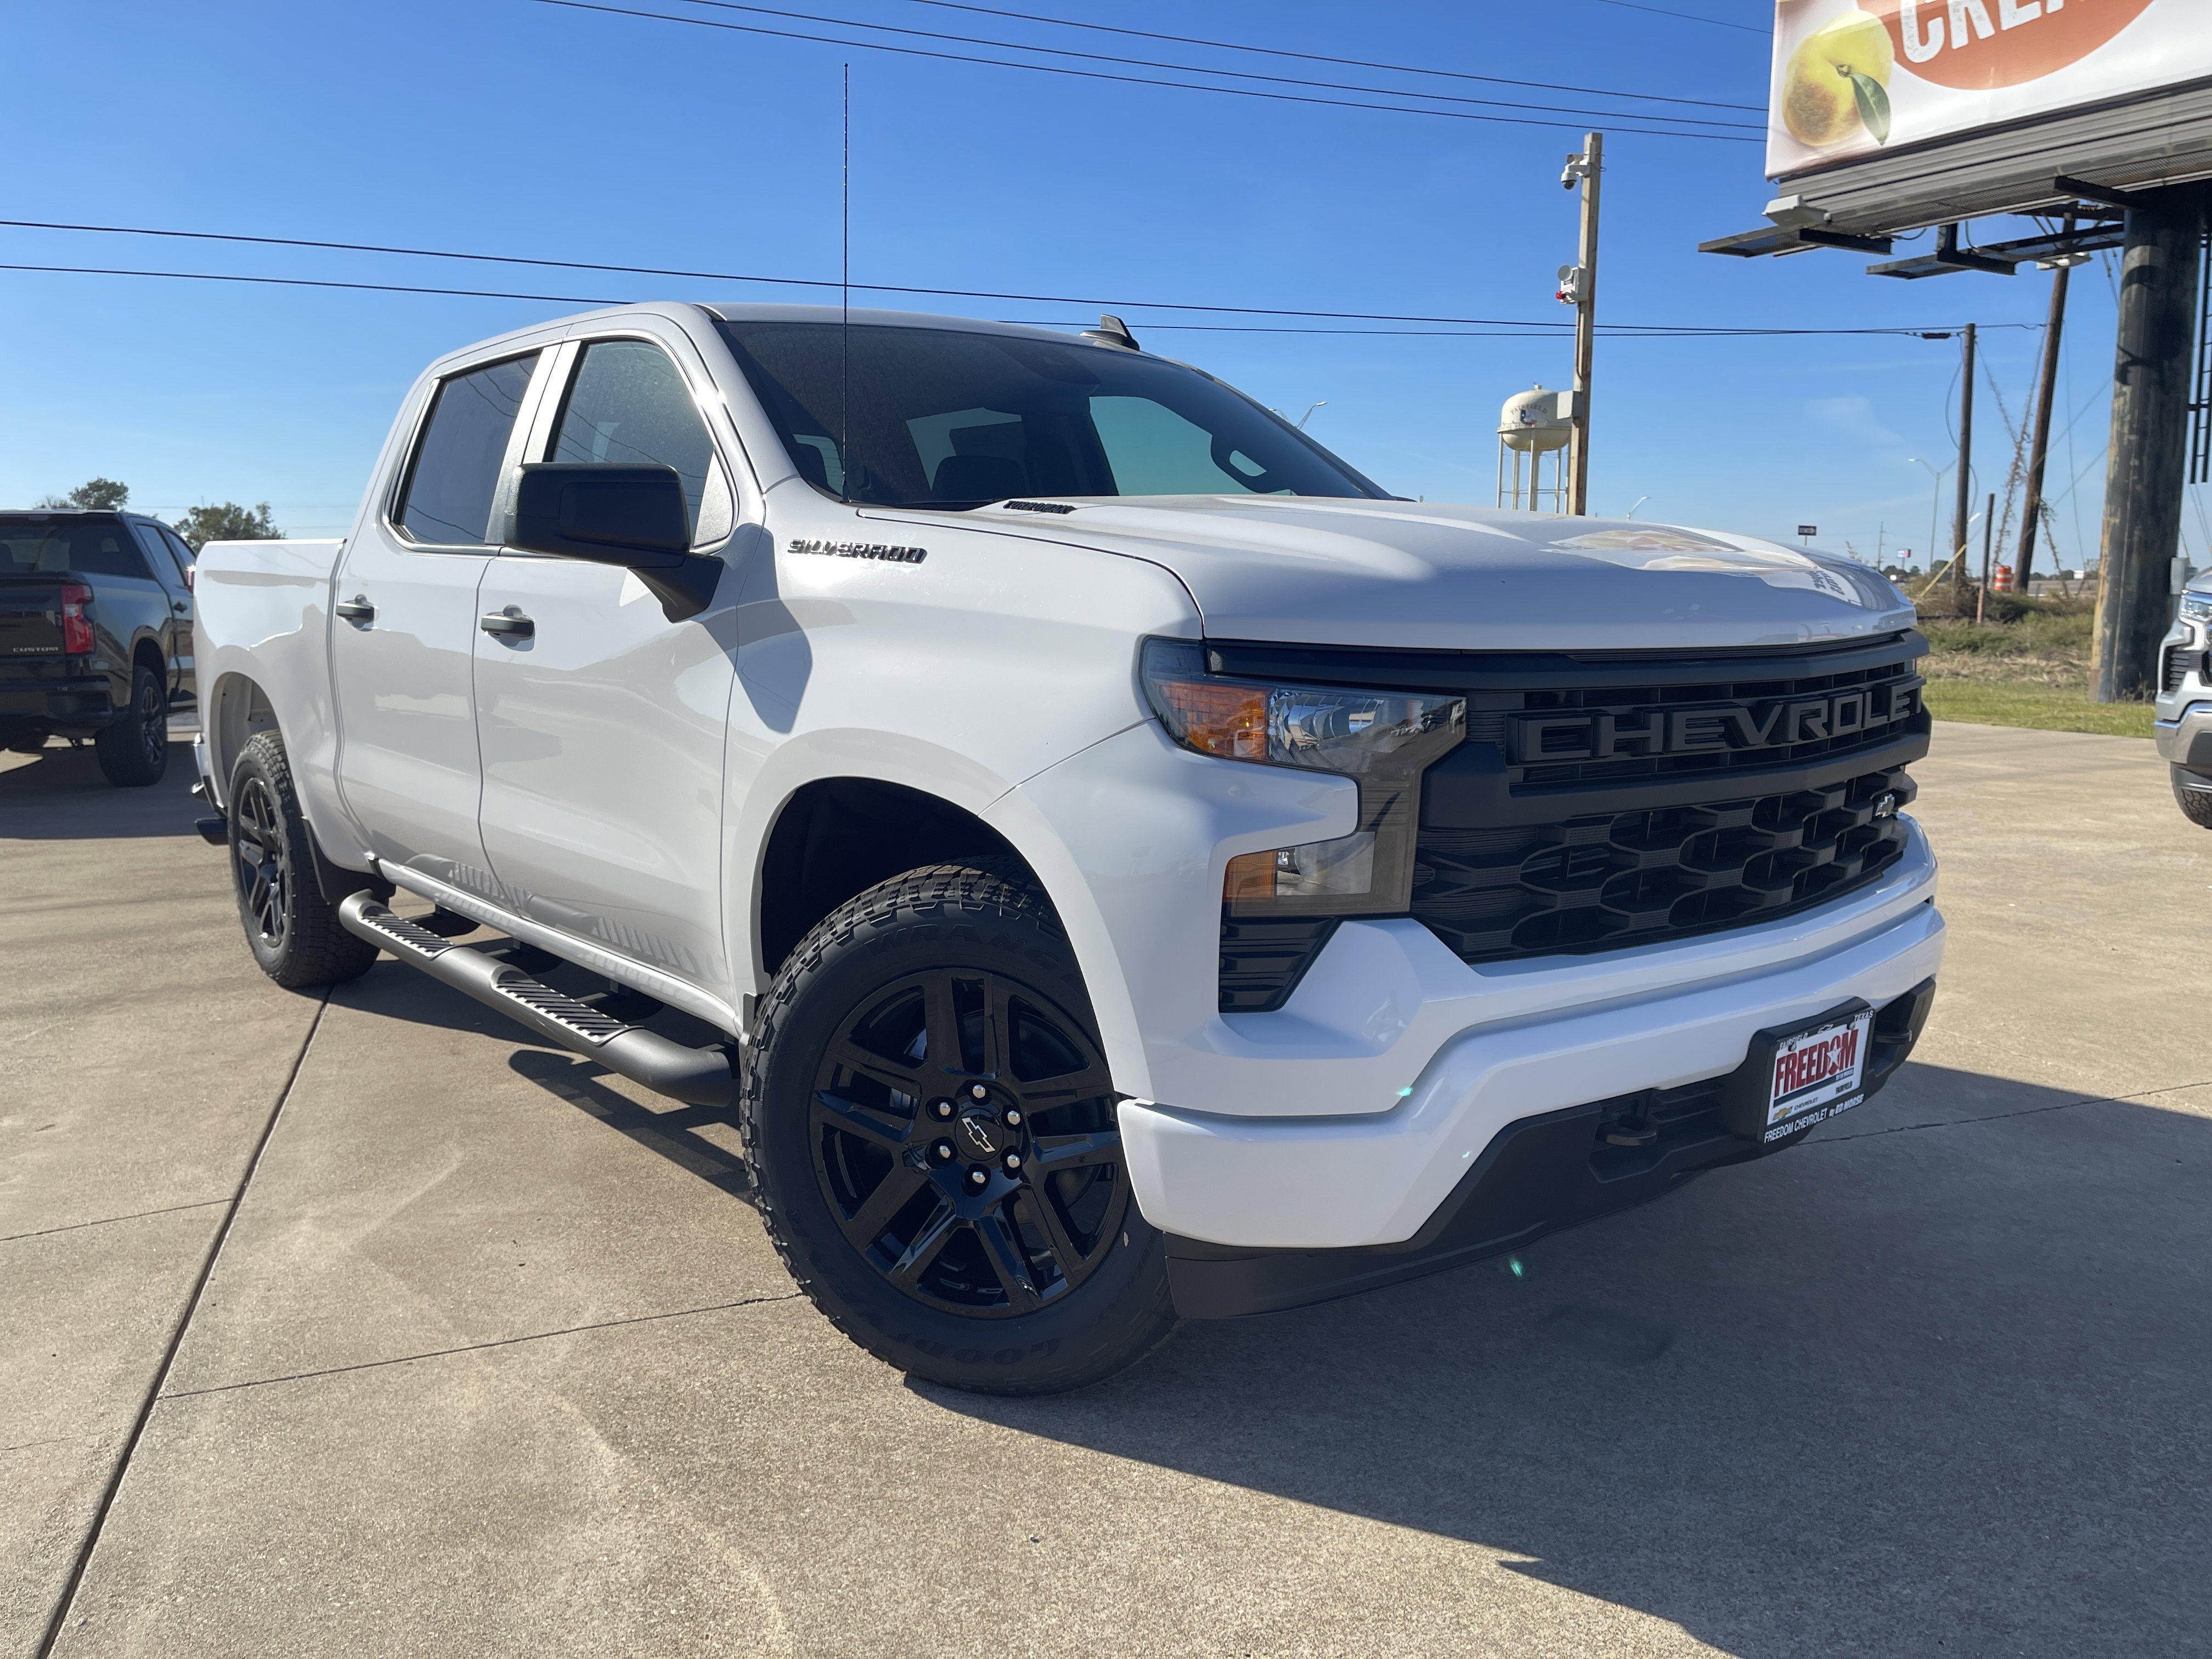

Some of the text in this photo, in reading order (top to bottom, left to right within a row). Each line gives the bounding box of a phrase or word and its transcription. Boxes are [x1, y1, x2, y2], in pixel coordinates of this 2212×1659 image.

[788, 539, 928, 565] SILVERADO
[1516, 676, 1927, 764] CHEVROLET
[1854, 1010, 1874, 1023] TEXAS
[1774, 1029, 1859, 1098] FREEDOM
[1794, 1097, 1819, 1110] CHEVROLET
[1764, 1122, 1795, 1144] FREEDOM
[1795, 1107, 1828, 1132] CHEVROLET
